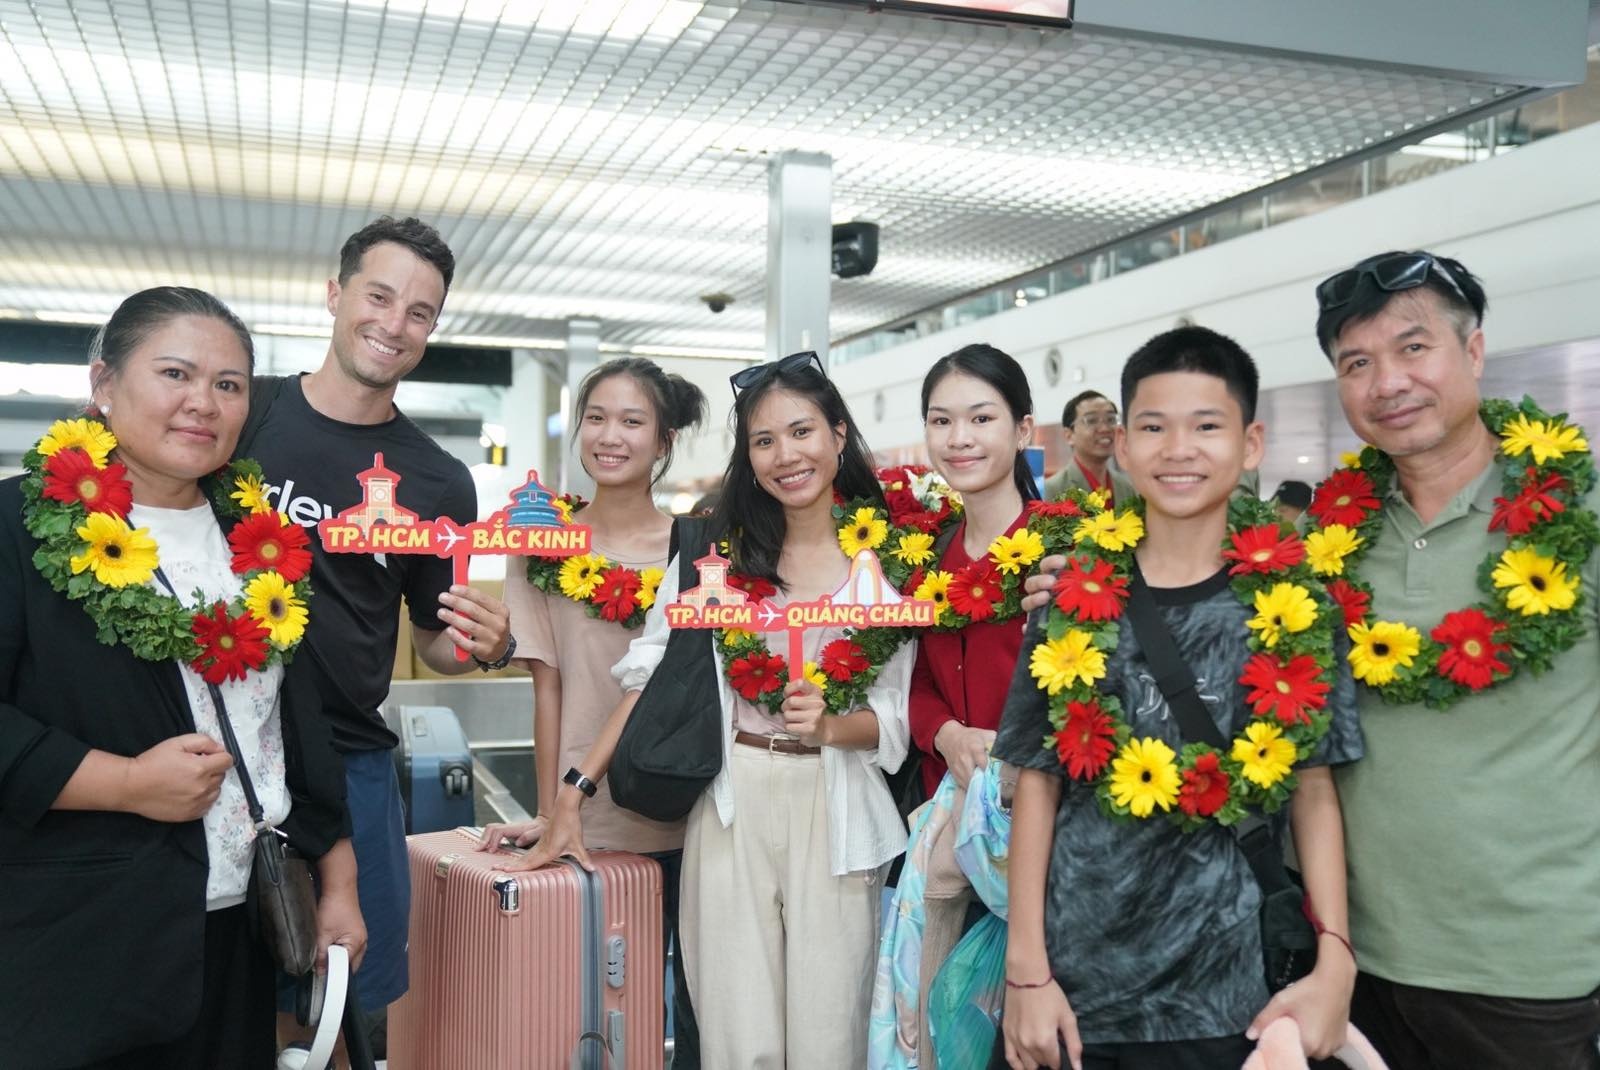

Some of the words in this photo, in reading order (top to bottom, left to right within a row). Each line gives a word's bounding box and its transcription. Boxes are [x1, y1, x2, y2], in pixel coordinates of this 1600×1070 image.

[371, 527, 431, 548] HCM
[472, 517, 523, 549] BẮC
[527, 530, 587, 549] KINH
[704, 607, 752, 624] HCM
[787, 599, 865, 627] QUẢNG
[869, 602, 930, 622] CHÂU
